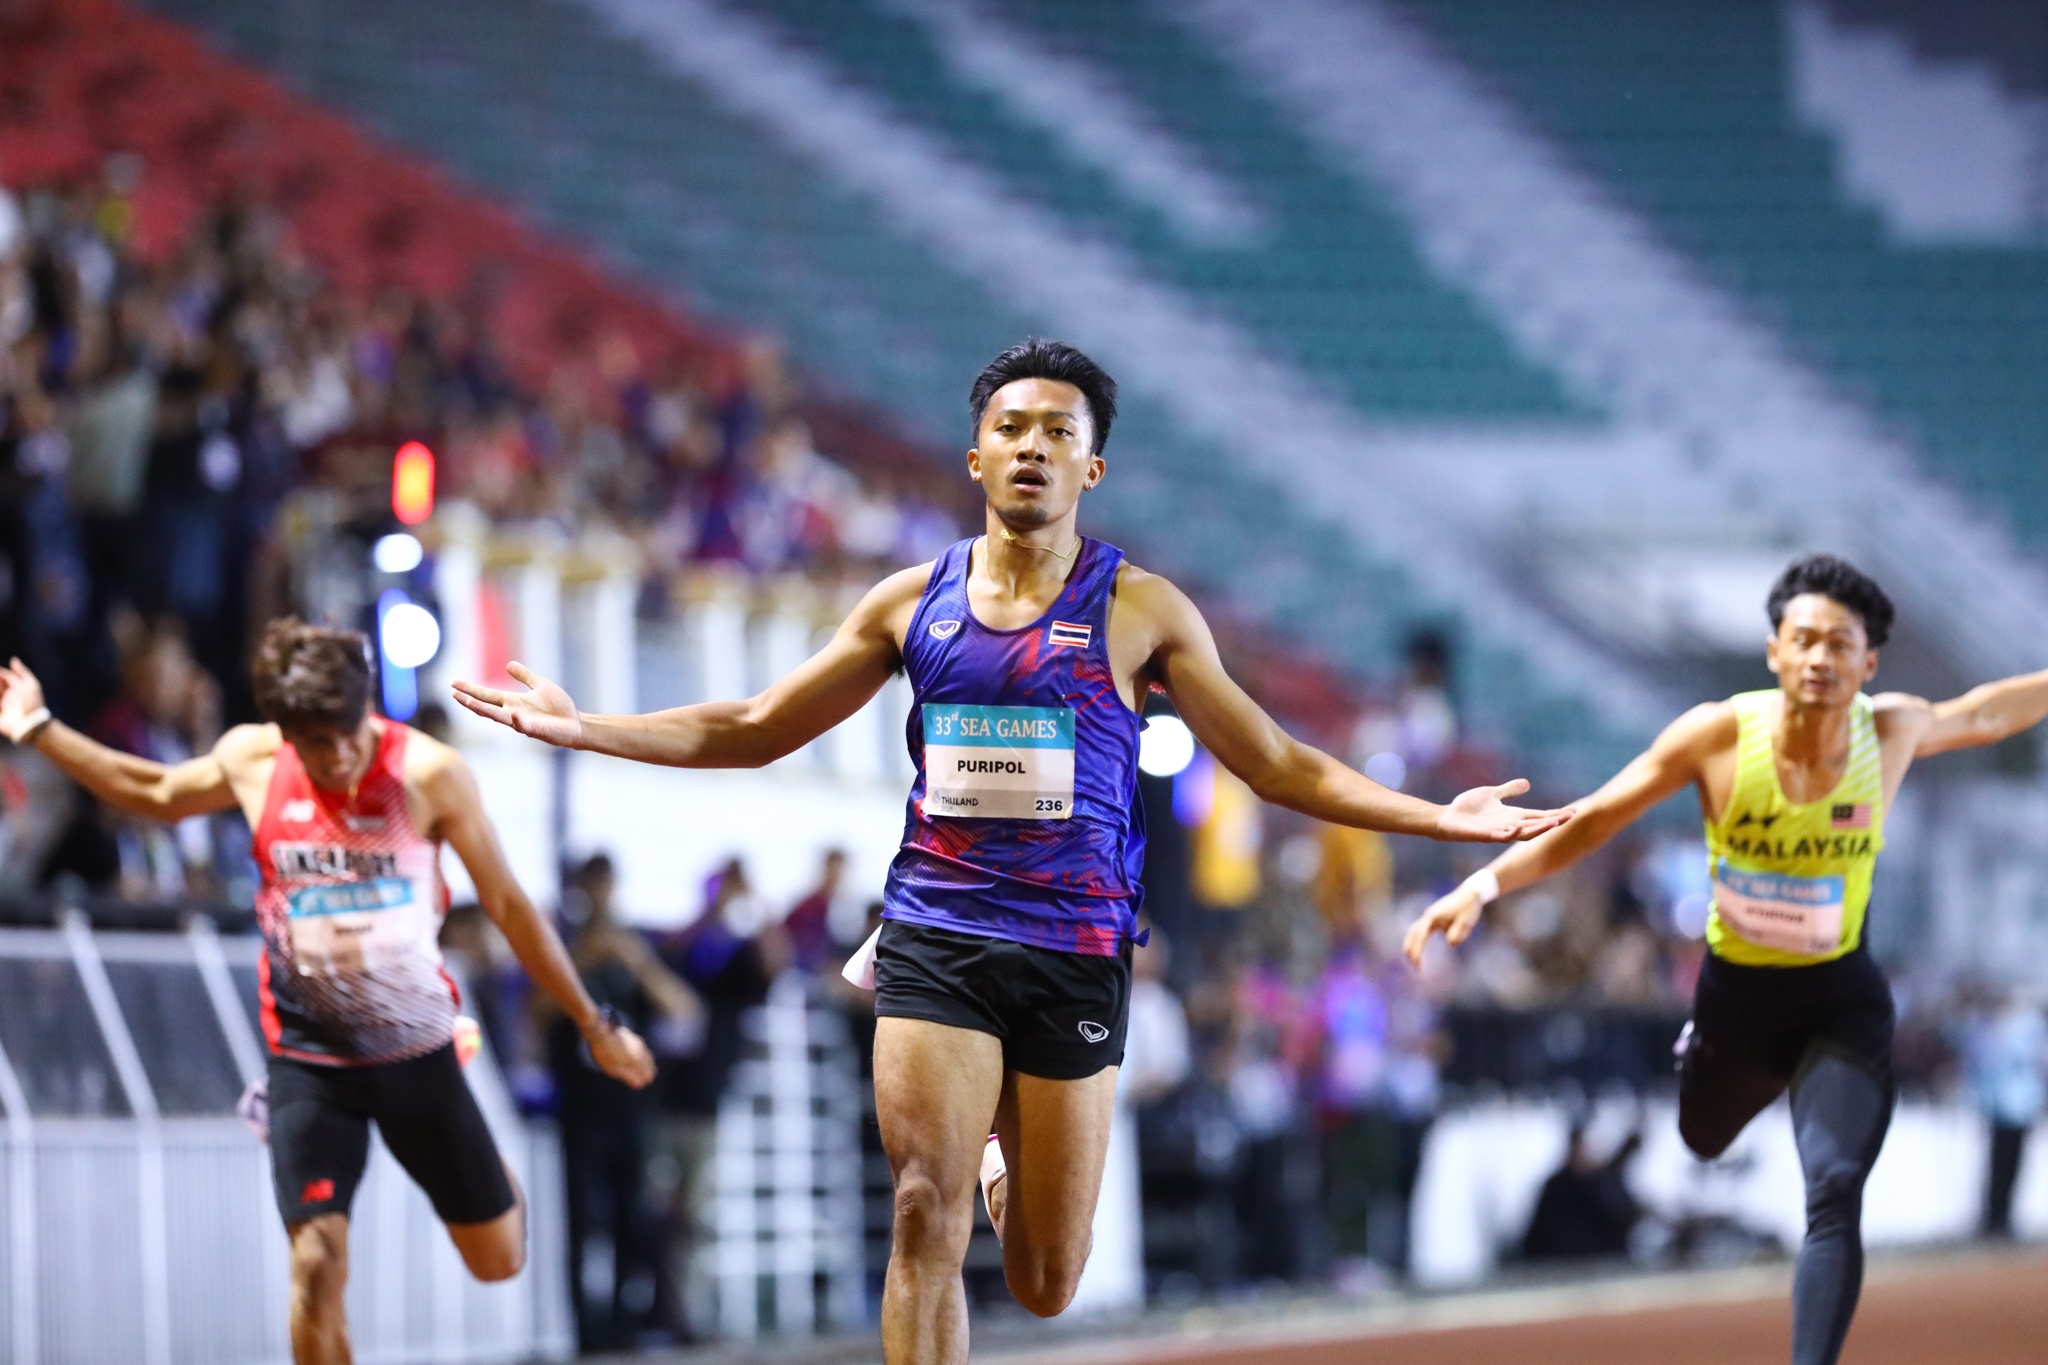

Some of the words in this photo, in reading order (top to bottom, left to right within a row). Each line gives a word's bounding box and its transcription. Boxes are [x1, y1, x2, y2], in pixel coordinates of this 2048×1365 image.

[960, 717, 991, 737] SEA
[996, 718, 1057, 739] GAMES
[957, 759, 1026, 774] PURIPOL
[941, 796, 979, 806] THAILAND
[1035, 799, 1063, 811] 236
[1726, 834, 1872, 859] MALAYSIA
